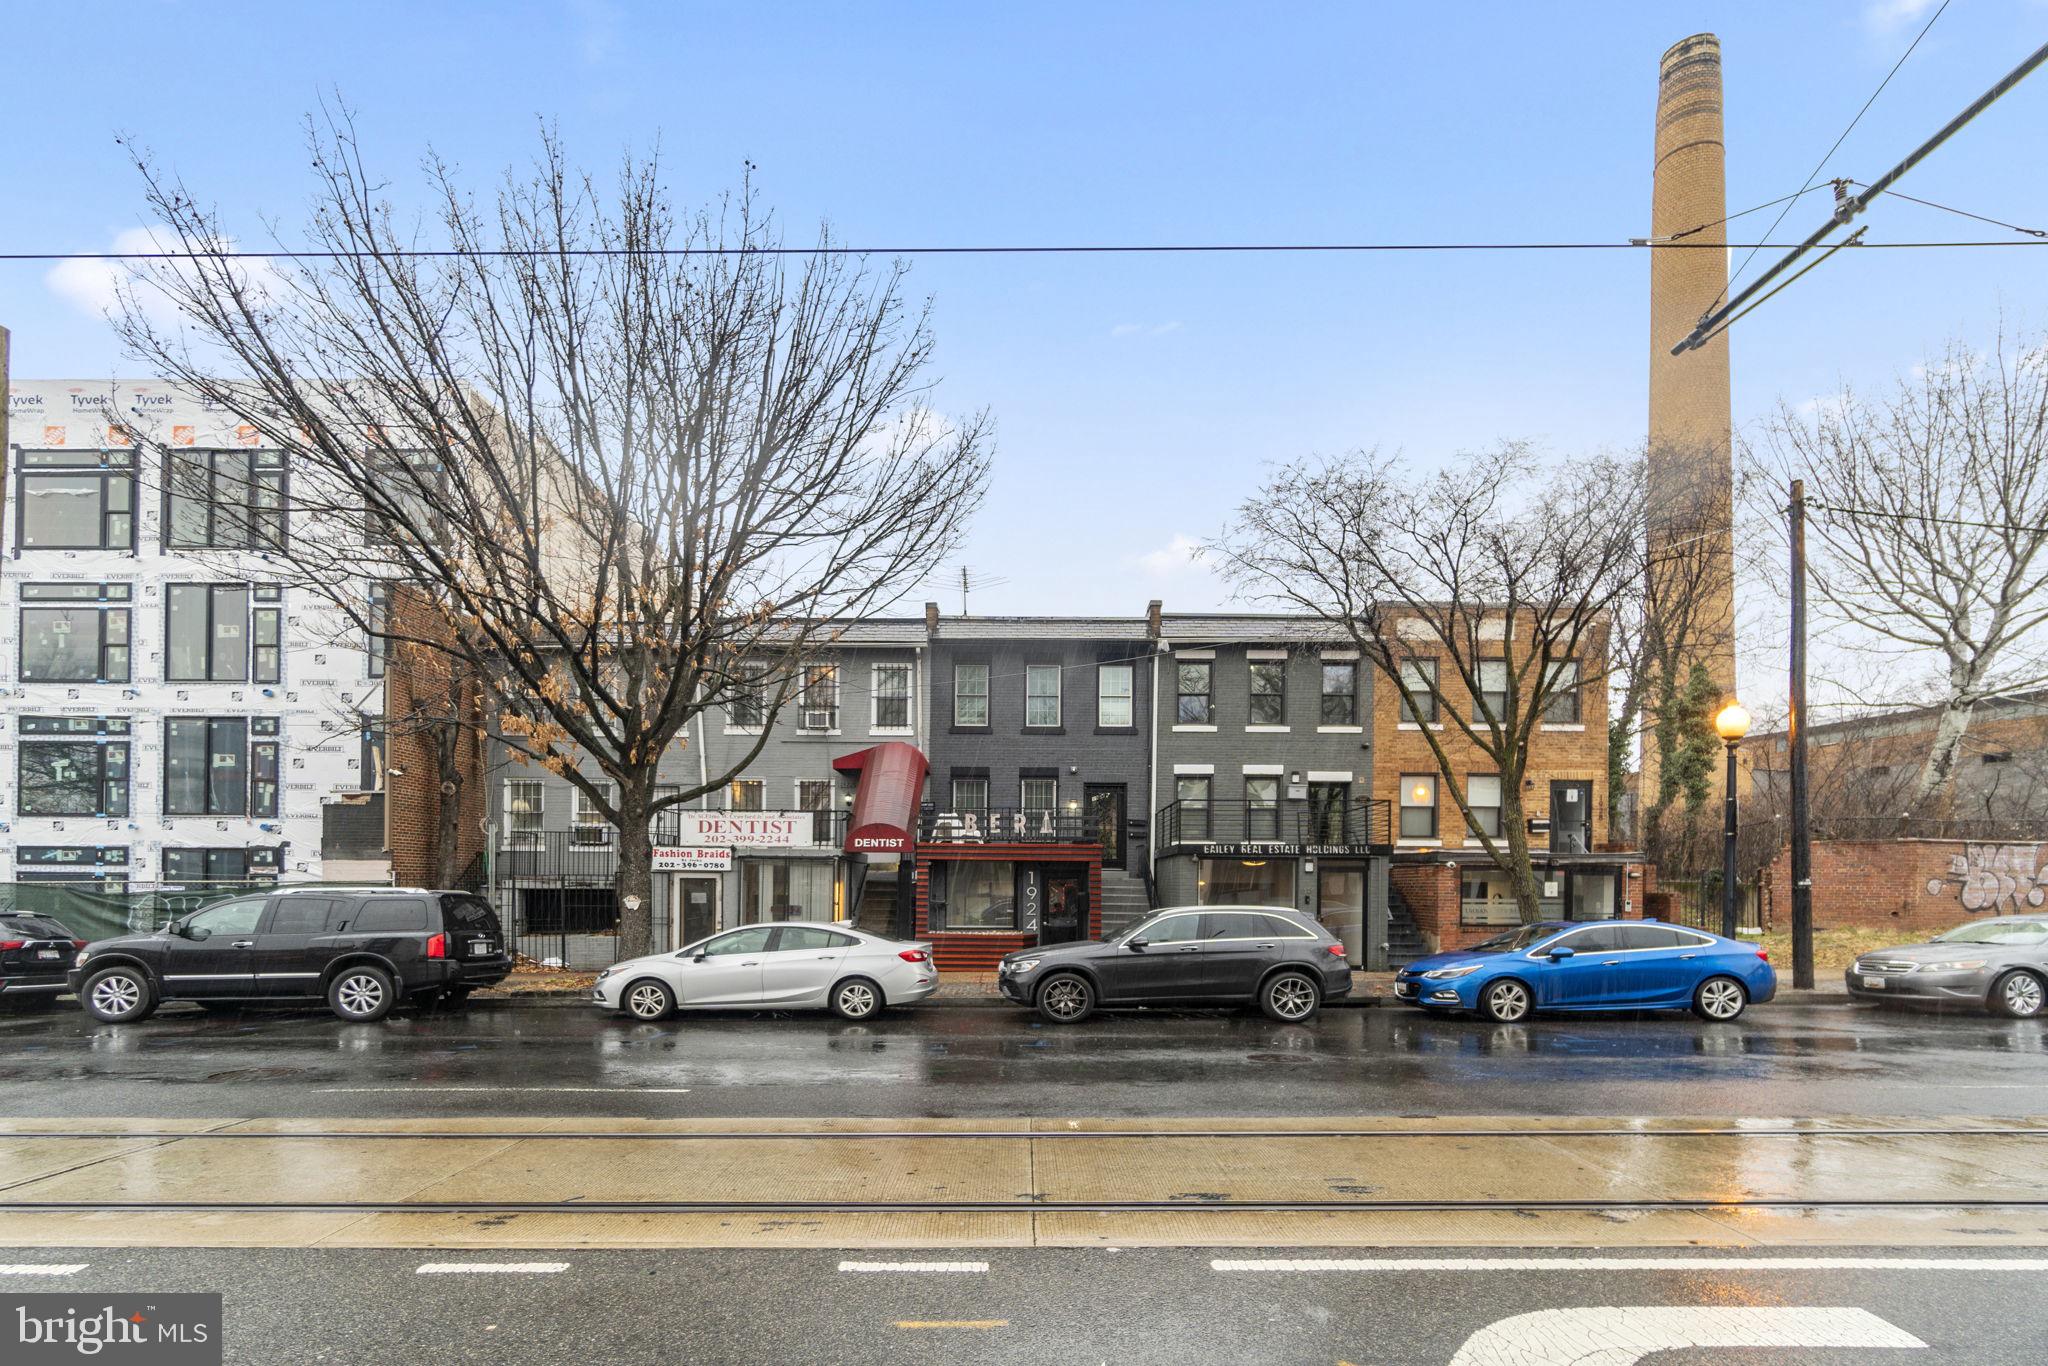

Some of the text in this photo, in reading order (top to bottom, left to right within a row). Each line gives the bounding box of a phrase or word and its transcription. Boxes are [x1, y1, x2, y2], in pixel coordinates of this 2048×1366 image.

[9, 394, 44, 407] Tyvek
[70, 394, 108, 407] Tyvek
[135, 394, 173, 407] Tyvek
[698, 820, 798, 834] DENTIST
[704, 835, 790, 844] 202-399-2244
[854, 838, 905, 848] DENTIST
[653, 848, 731, 858] Fashion Braids
[1240, 844, 1264, 854] REAL
[1268, 844, 1300, 854] ESTATE
[1306, 844, 1350, 854] HOLDINGS
[1355, 845, 1371, 854] LLC
[1026, 871, 1038, 931] 1924
